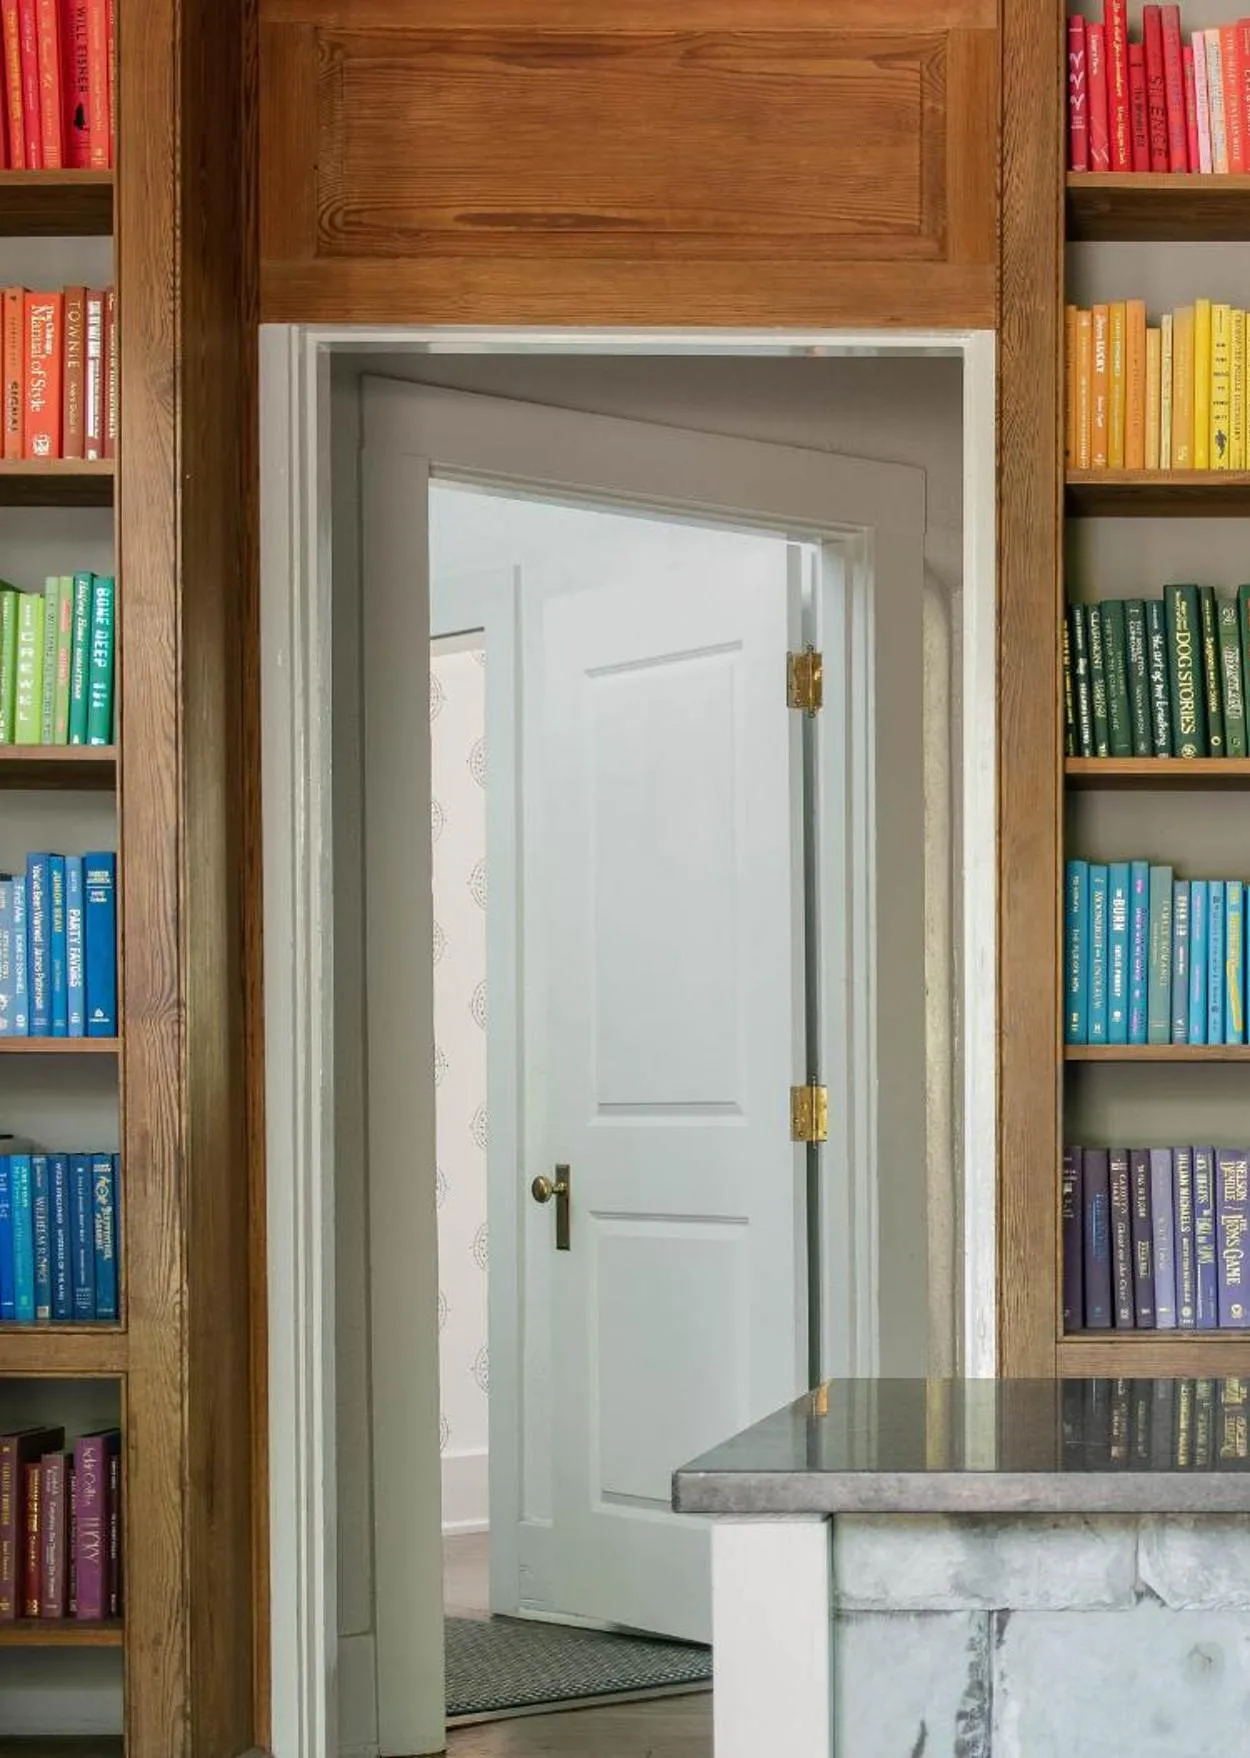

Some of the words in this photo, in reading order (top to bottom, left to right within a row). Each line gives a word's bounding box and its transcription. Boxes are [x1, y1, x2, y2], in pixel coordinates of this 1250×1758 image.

[76, 6, 86, 40] WILL
[77, 46, 88, 92] EISNER
[31, 305, 47, 358] Manual
[68, 301, 81, 368] TOWNIE
[31, 361, 46, 376] of
[31, 379, 46, 412] Style
[95, 587, 110, 625] BONE
[93, 629, 109, 667] DEEP
[1176, 631, 1192, 668] DOG
[1178, 670, 1196, 734] STORIES
[33, 889, 43, 910] Been
[53, 872, 61, 905] JUNIOR
[34, 911, 43, 942] Warned
[69, 909, 80, 944] PARTY
[1112, 899, 1126, 932] BURN
[69, 947, 81, 988] FAVORS
[1178, 1154, 1190, 1185] JILLIAN
[1220, 1161, 1237, 1202] DEMILLE
[1236, 1161, 1248, 1200] NELSON
[1179, 1187, 1192, 1233] MICHAELS
[1223, 1249, 1244, 1286] GAME
